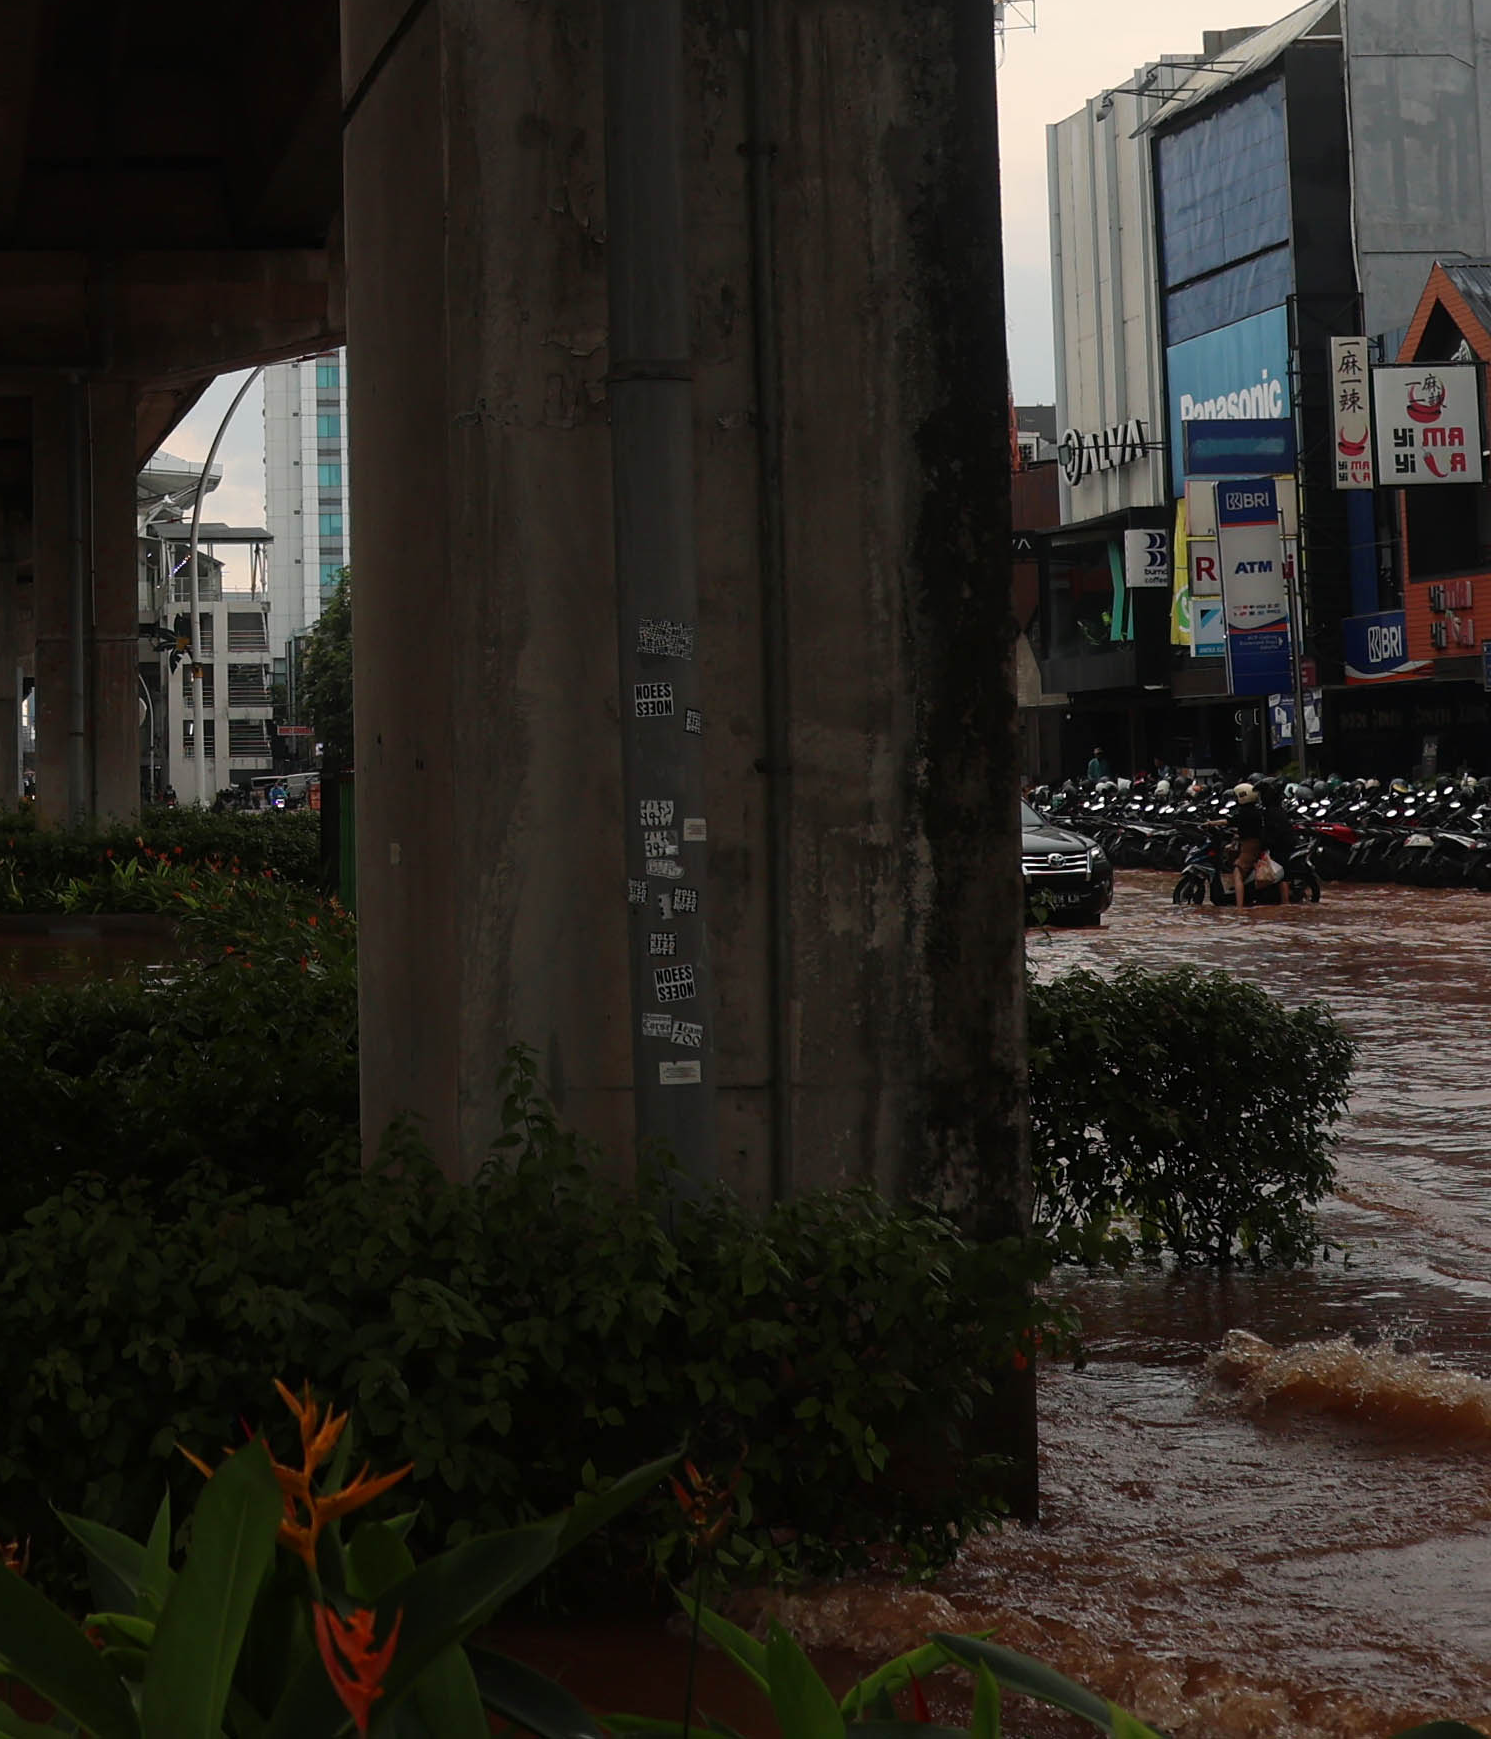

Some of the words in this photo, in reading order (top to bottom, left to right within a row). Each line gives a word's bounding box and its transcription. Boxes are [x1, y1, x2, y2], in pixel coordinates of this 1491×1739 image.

[1338, 341, 1364, 413] 一麻一辣
[1180, 368, 1283, 421] Panasonic
[1242, 492, 1270, 509] BRI
[1234, 560, 1273, 575] ATM
[1381, 625, 1403, 659] BRI
[635, 683, 672, 700] NOEES
[655, 965, 693, 985] NOEES
[673, 1031, 702, 1046] 700
